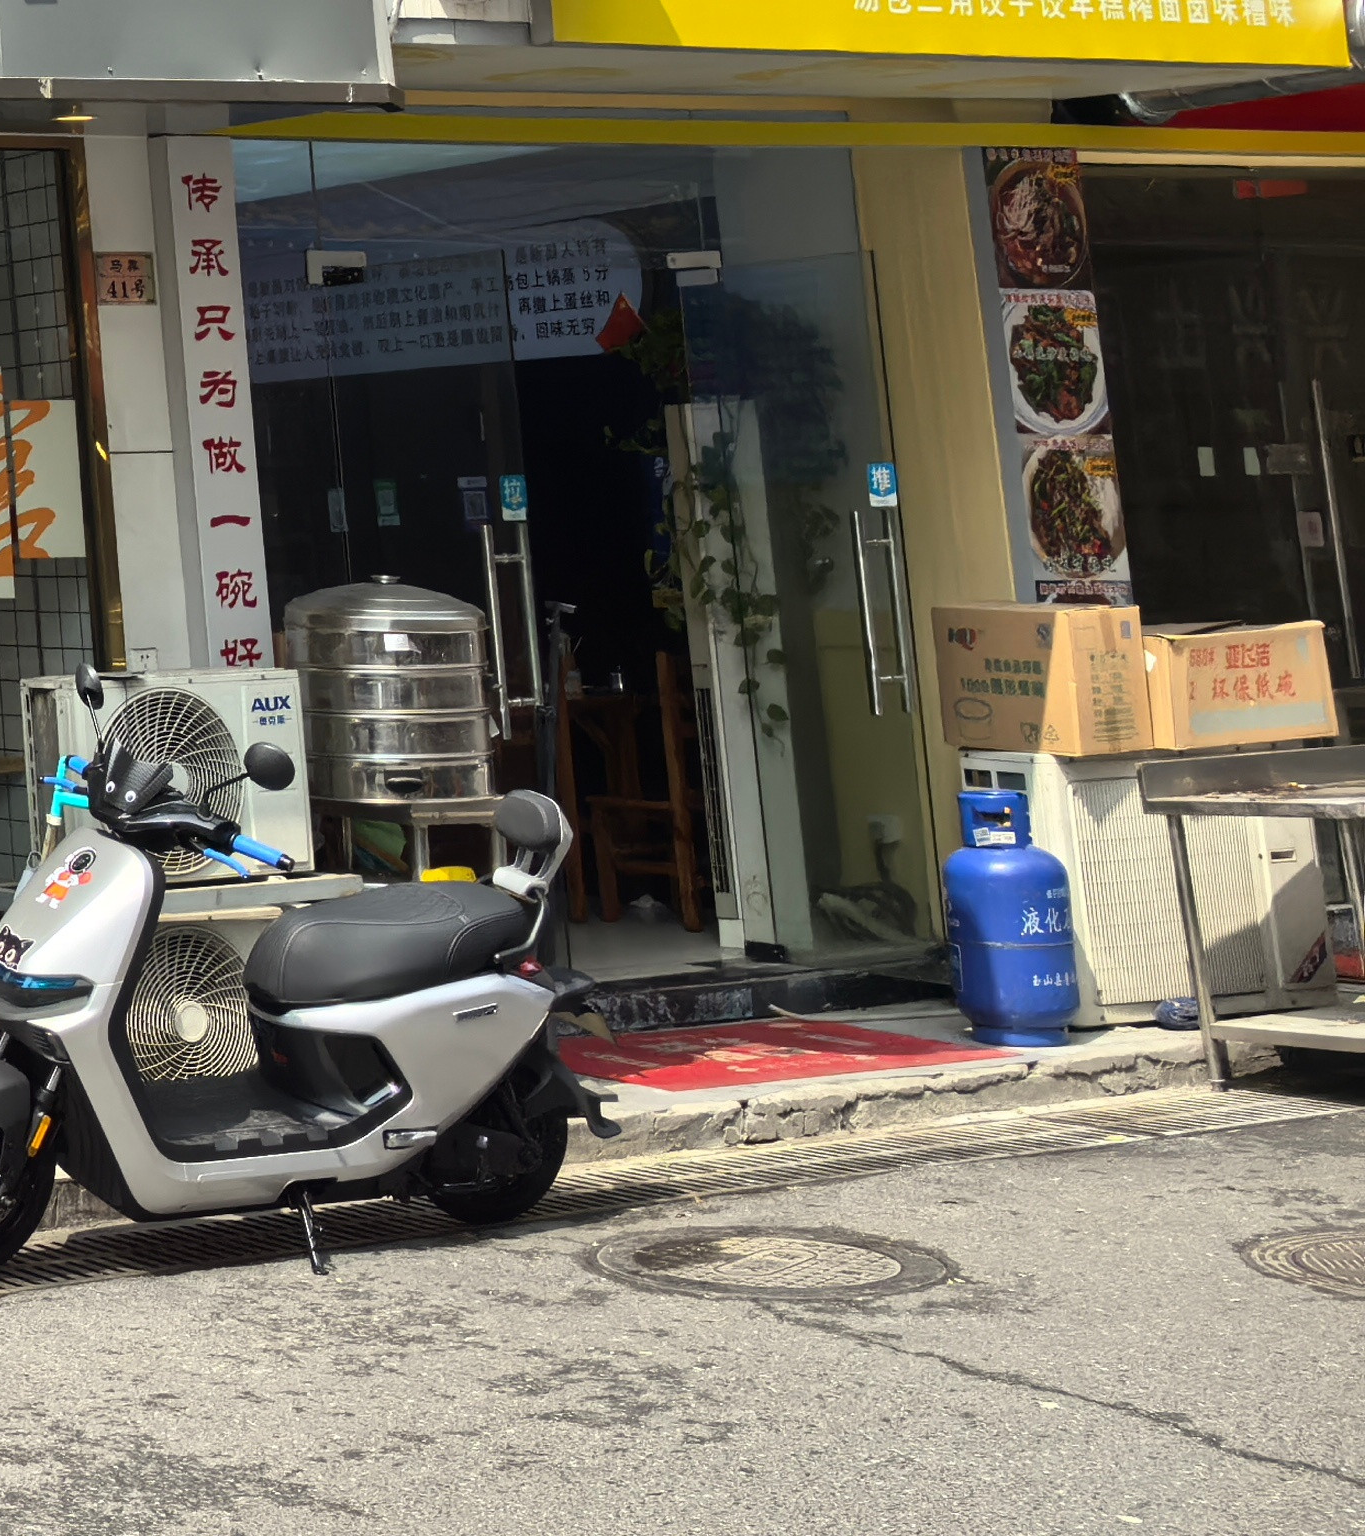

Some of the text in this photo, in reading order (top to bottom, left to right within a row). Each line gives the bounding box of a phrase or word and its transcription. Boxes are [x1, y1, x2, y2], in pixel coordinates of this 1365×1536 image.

[106, 278, 145, 300] 41号
[181, 173, 262, 667] 传承只为做一碗好
[251, 695, 292, 713] AUX
